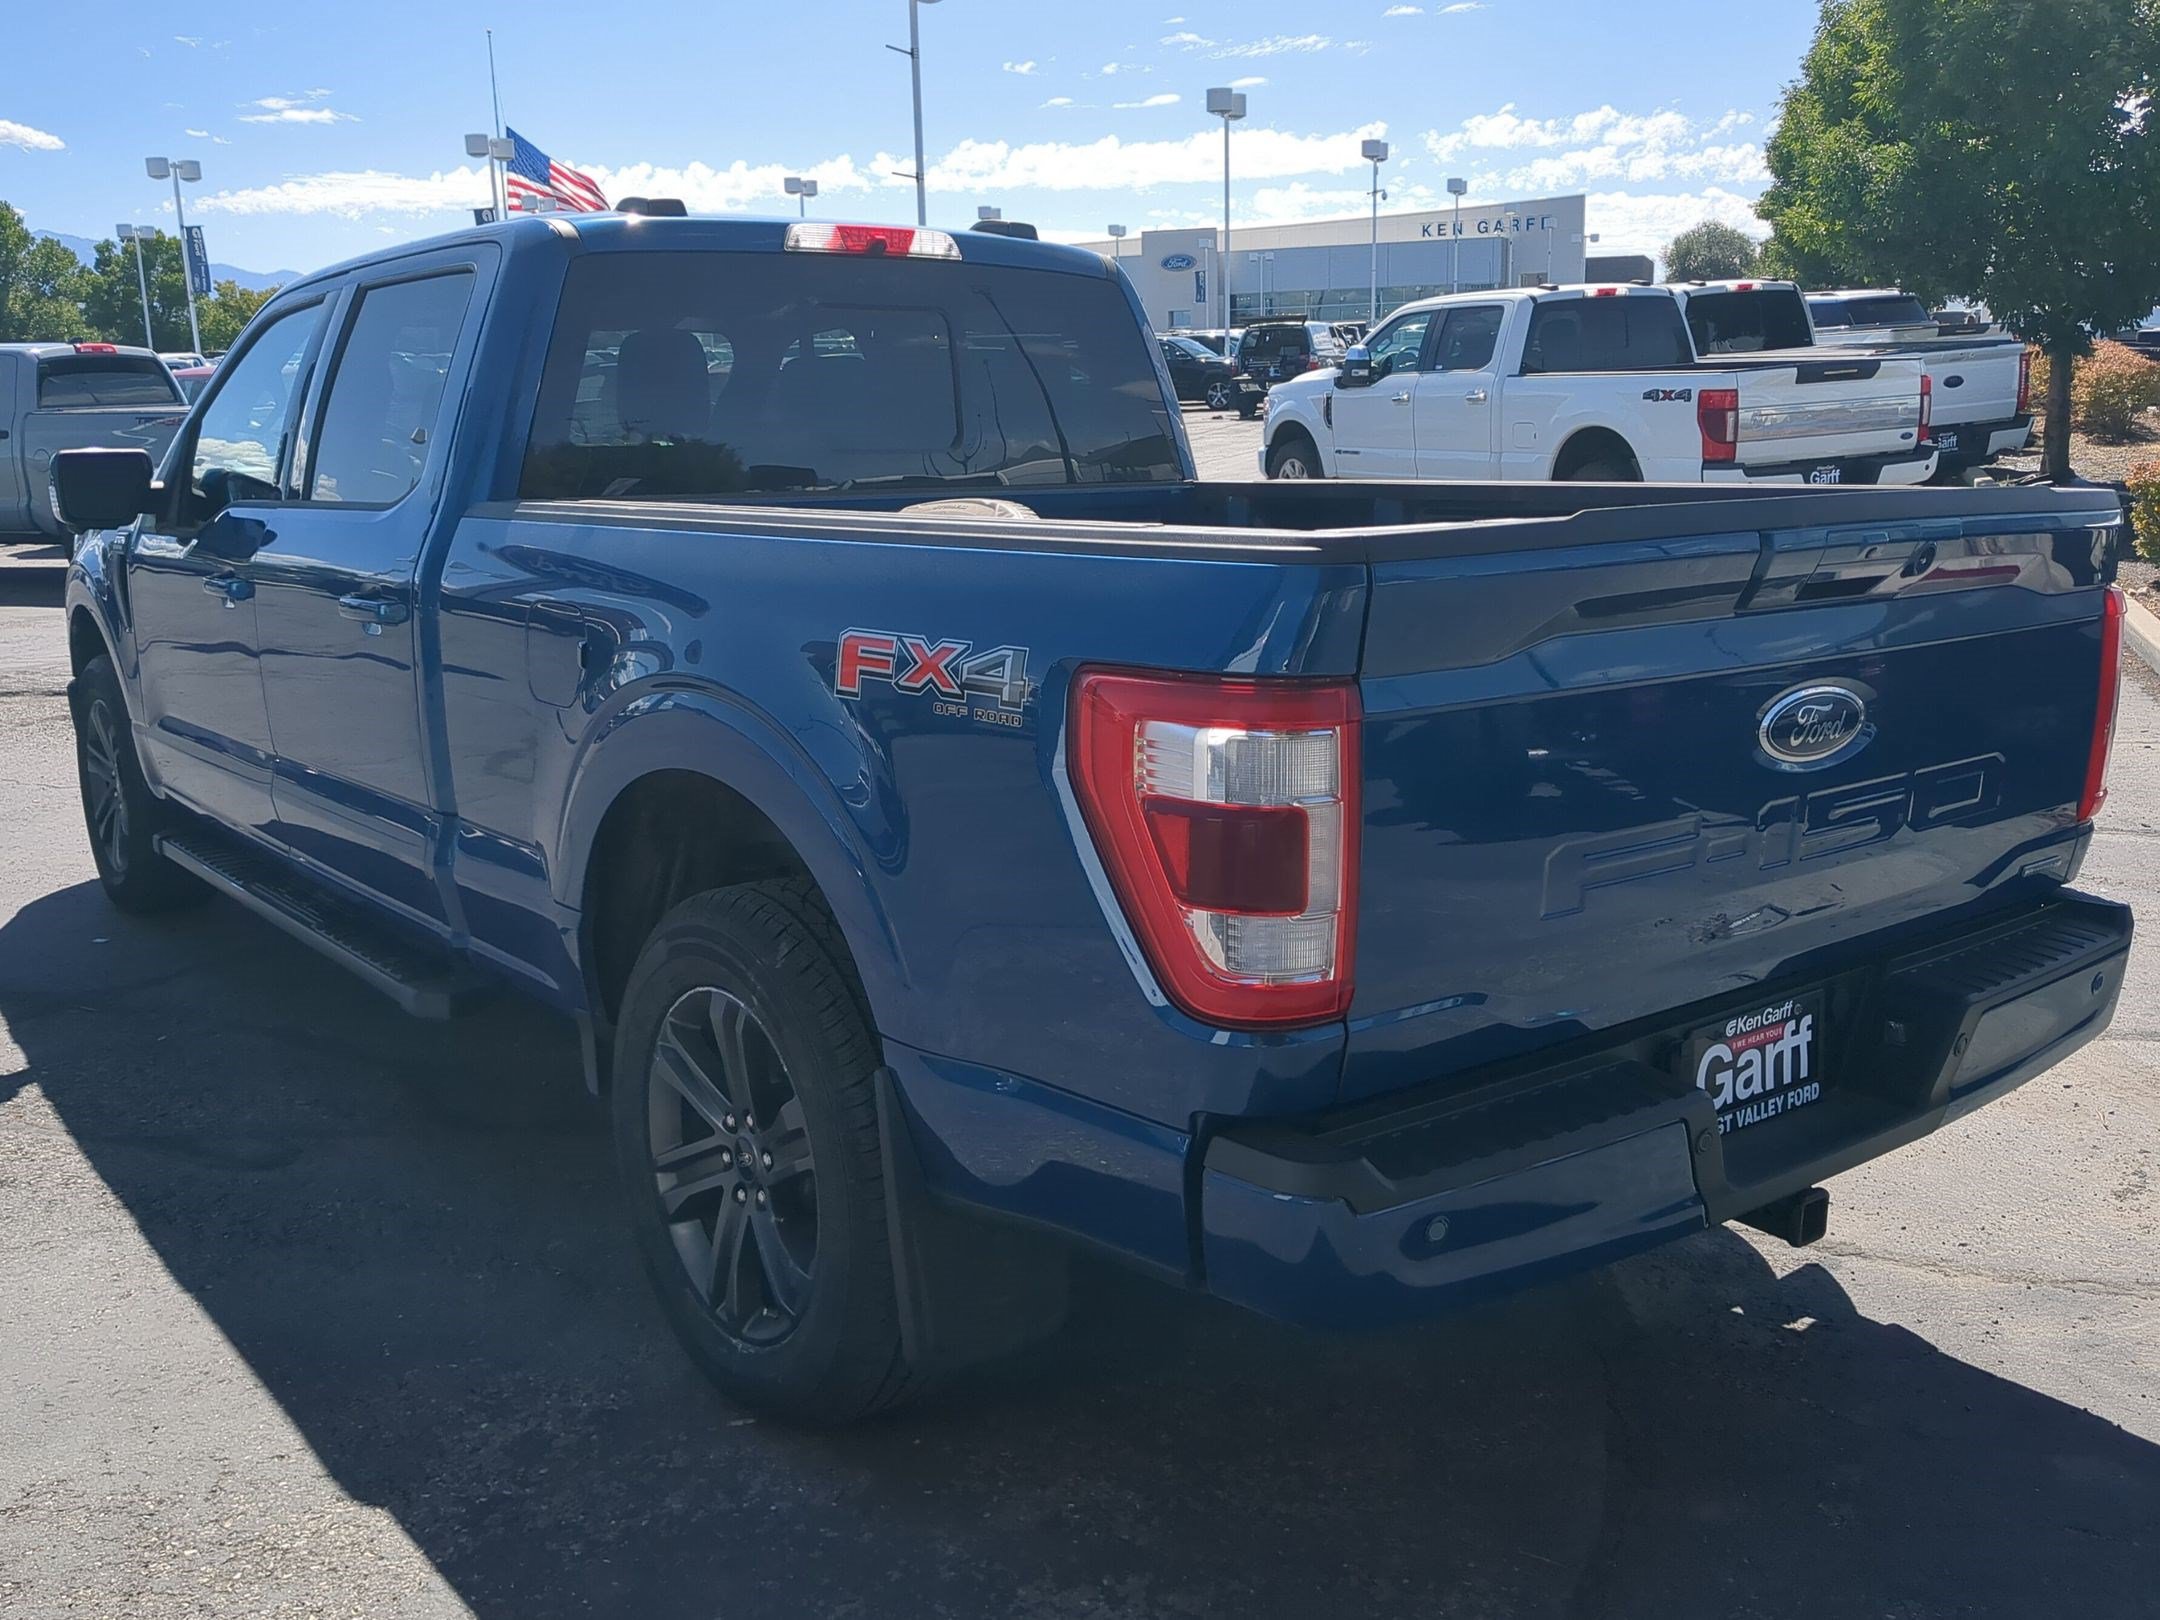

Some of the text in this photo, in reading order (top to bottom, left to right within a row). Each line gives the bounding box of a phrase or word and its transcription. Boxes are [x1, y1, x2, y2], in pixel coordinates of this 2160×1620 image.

[1422, 221, 1463, 238] KEN
[1810, 469, 1840, 484] Garff
[834, 626, 1029, 711] FX4
[932, 703, 1023, 728] OFF ROAD
[1788, 703, 1849, 748] Ford
[1540, 752, 2005, 921] F-150
[1737, 1015, 1761, 1034] Ken
[1762, 1000, 1793, 1026] Garff
[1748, 1033, 1765, 1044] HEAR
[1696, 1014, 1812, 1110] Garff
[1736, 1094, 1784, 1128] VALLEY
[1787, 1082, 1820, 1110] FORD
